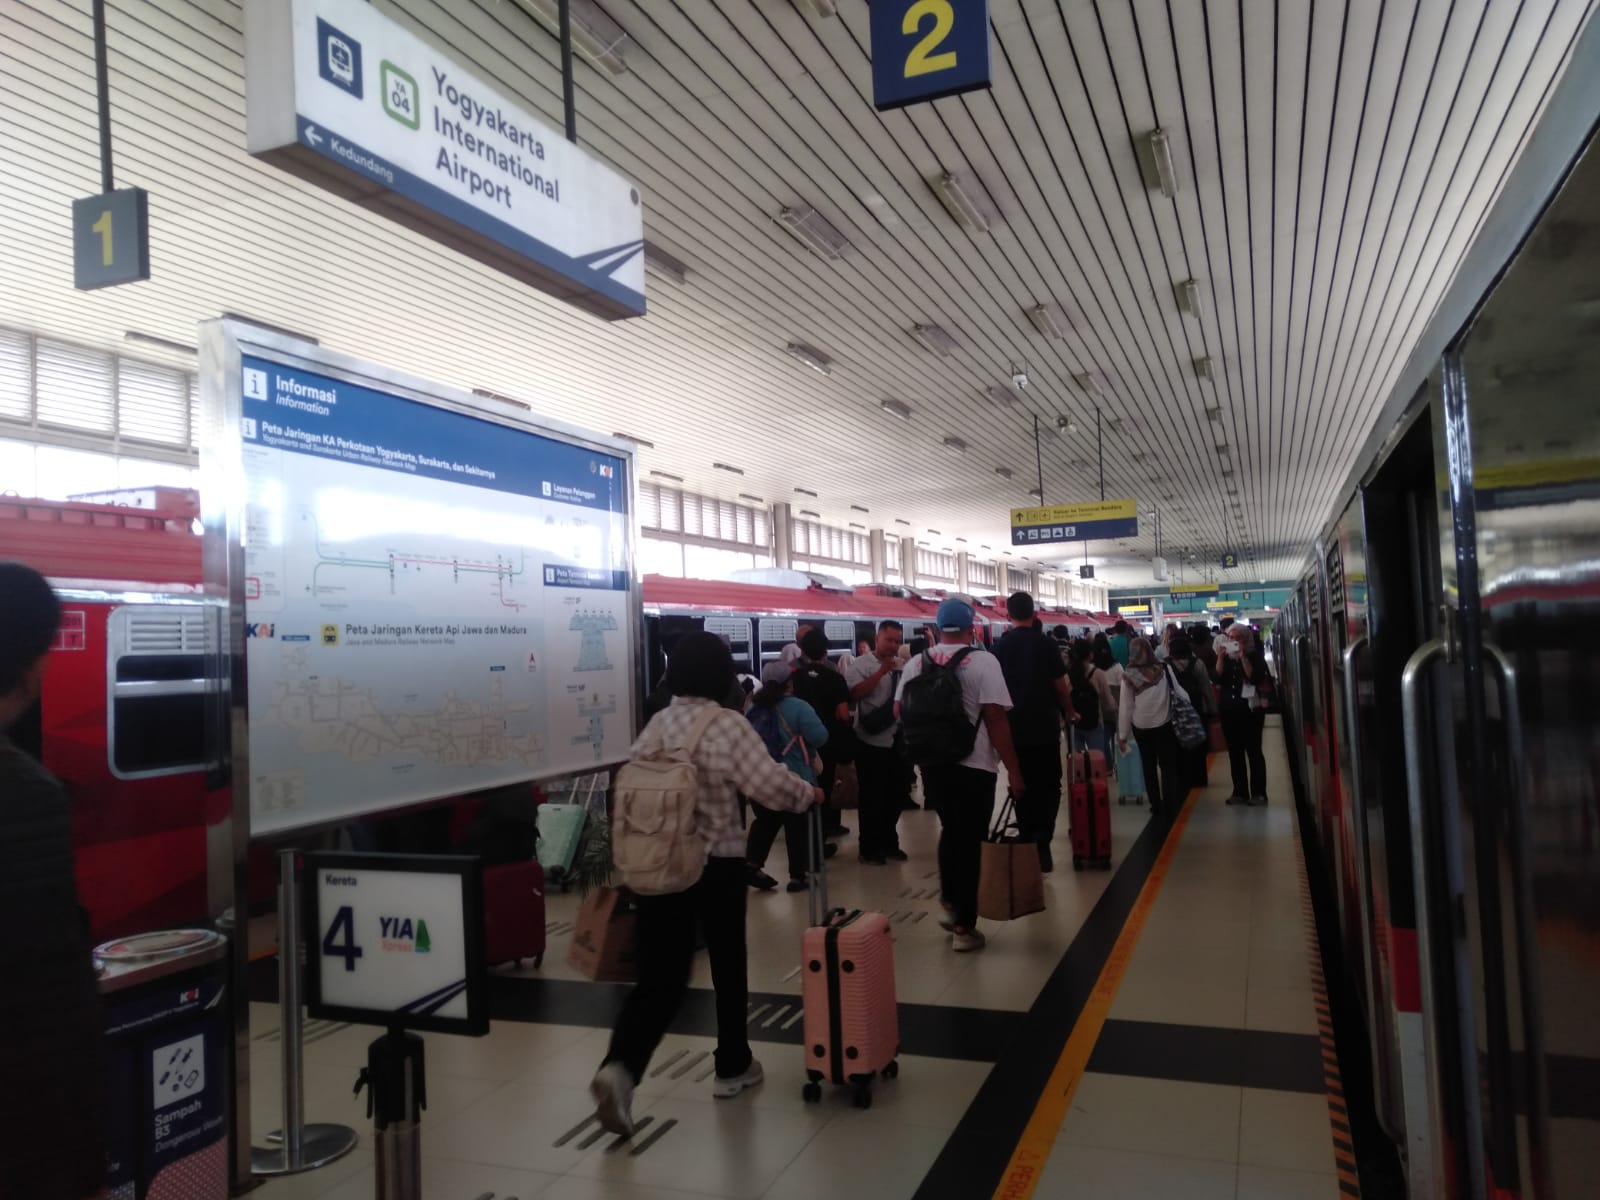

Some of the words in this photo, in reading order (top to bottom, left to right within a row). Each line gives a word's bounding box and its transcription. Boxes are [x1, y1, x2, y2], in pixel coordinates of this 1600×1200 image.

[901, 0, 957, 78] 2
[394, 79, 406, 95] YA
[392, 91, 410, 112] 04
[431, 65, 546, 161] Yogyakarta
[330, 137, 394, 184] Kedundang
[433, 106, 560, 203] International
[435, 147, 513, 209] Airport
[92, 209, 114, 266] 1
[276, 375, 337, 404] Informasi
[275, 393, 331, 416] Information
[262, 421, 282, 436] Peta
[284, 427, 321, 444] Jaringan
[322, 434, 335, 446] KA
[337, 438, 375, 455] Perkotaan
[1225, 555, 1234, 565] 2
[345, 623, 368, 636] Peta
[370, 623, 412, 638] Jaringan
[414, 624, 444, 635] Kereta
[445, 624, 460, 637] Api
[461, 625, 483, 636] Jawa
[484, 625, 497, 635] dan
[499, 625, 528, 636] Madura
[325, 874, 358, 887] Kereta
[322, 904, 363, 972] 4
[379, 916, 414, 940] YIA
[154, 1098, 202, 1126] Sampah
[154, 1123, 171, 1140] B3
